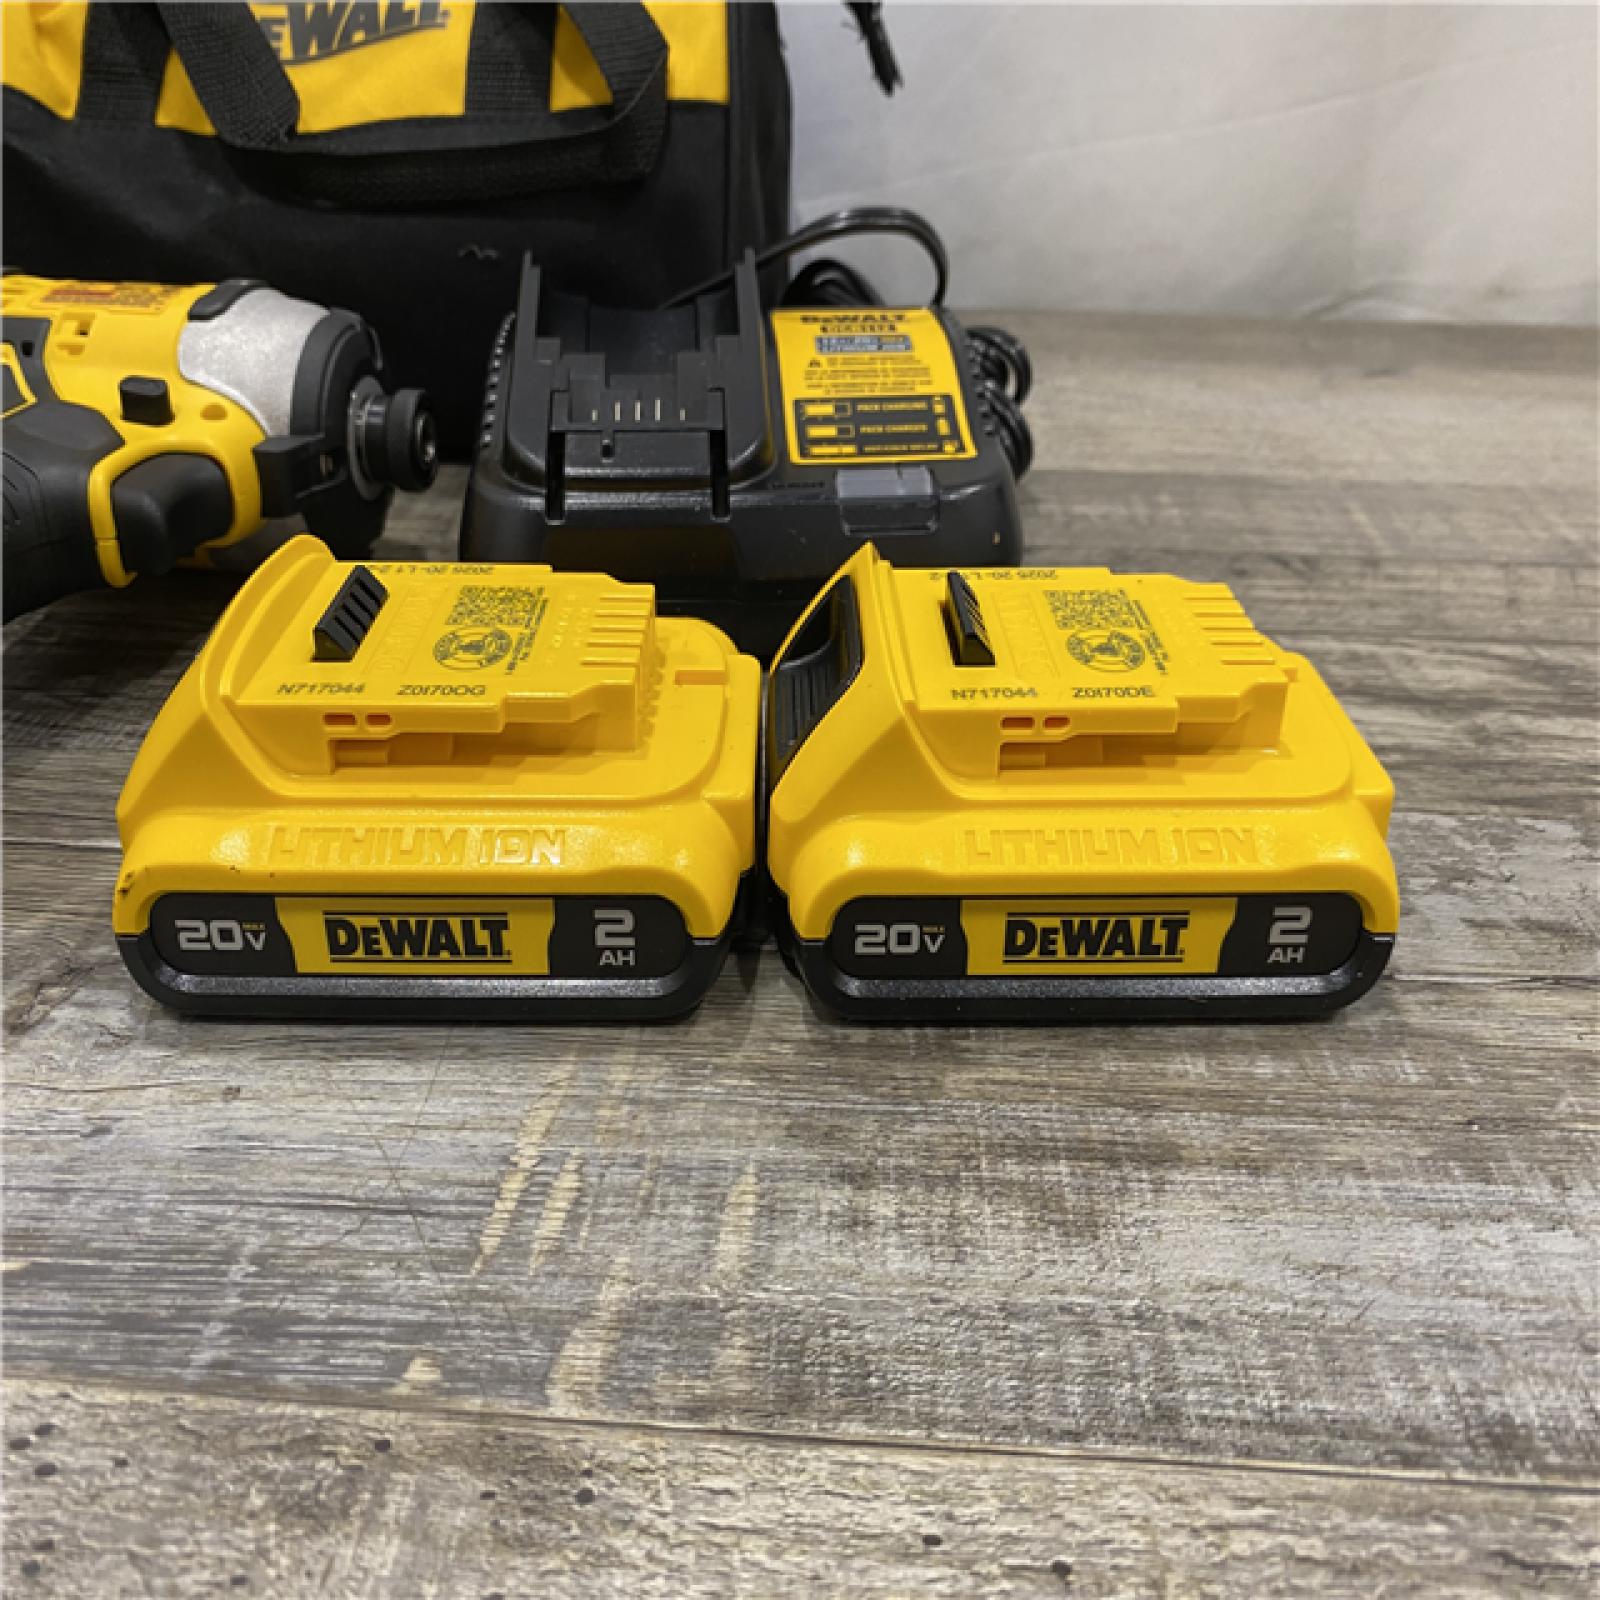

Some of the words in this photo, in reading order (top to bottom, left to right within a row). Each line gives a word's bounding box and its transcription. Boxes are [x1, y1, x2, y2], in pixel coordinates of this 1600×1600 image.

[266, 826, 469, 866] LITHIUM
[478, 827, 566, 866] ION
[963, 828, 1161, 867] LITHIUM
[1170, 827, 1259, 866] ION
[593, 908, 636, 948] 2
[1267, 906, 1313, 945] 2
[599, 950, 636, 967] AH
[1266, 946, 1306, 964] AH
